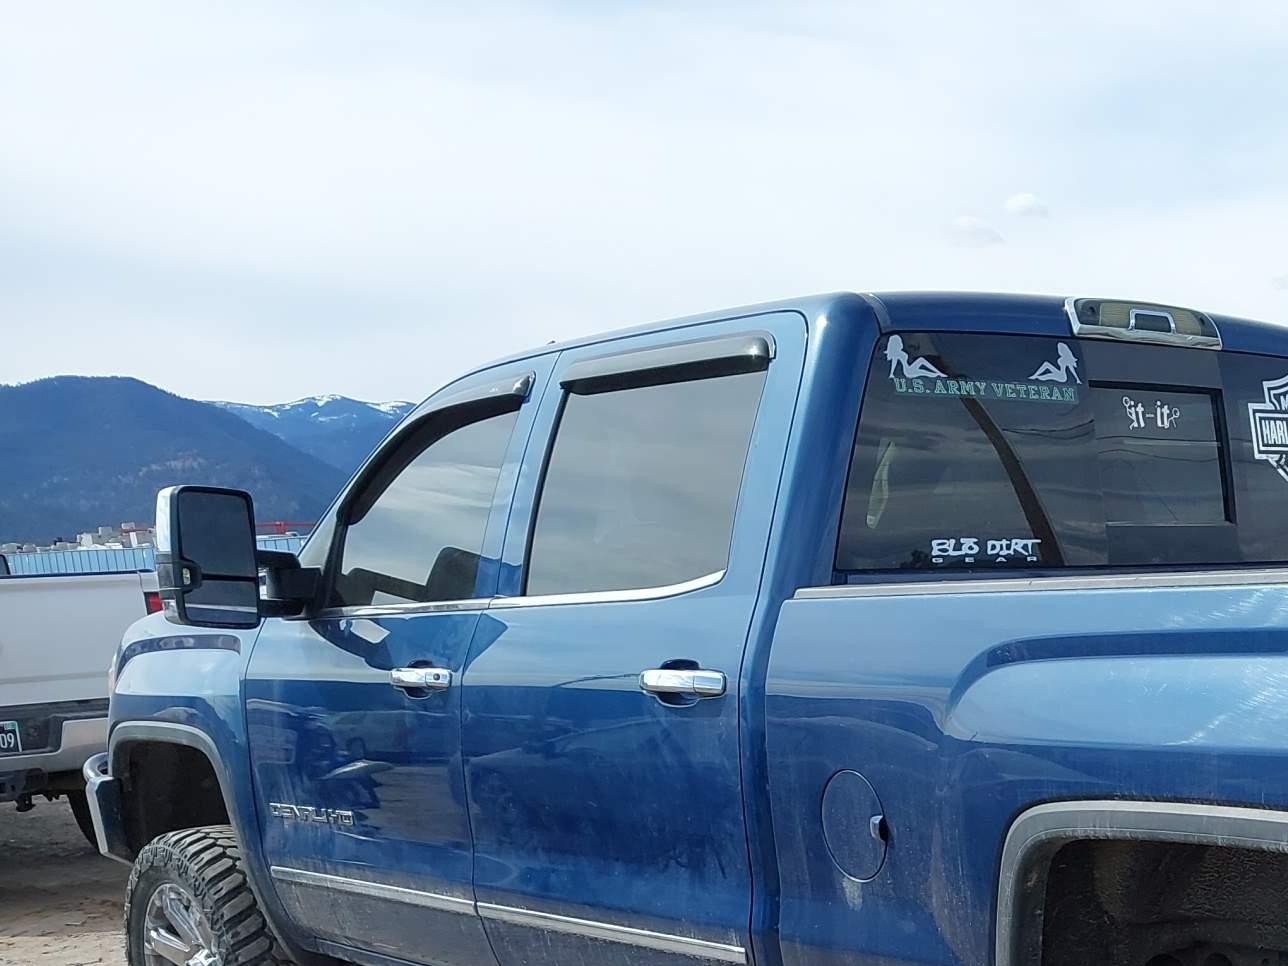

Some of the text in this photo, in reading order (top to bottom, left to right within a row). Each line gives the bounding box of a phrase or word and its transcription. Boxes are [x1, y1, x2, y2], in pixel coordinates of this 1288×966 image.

[894, 378, 1076, 401] U.S. ARMY VETERAN
[986, 538, 1042, 556] DIRT
